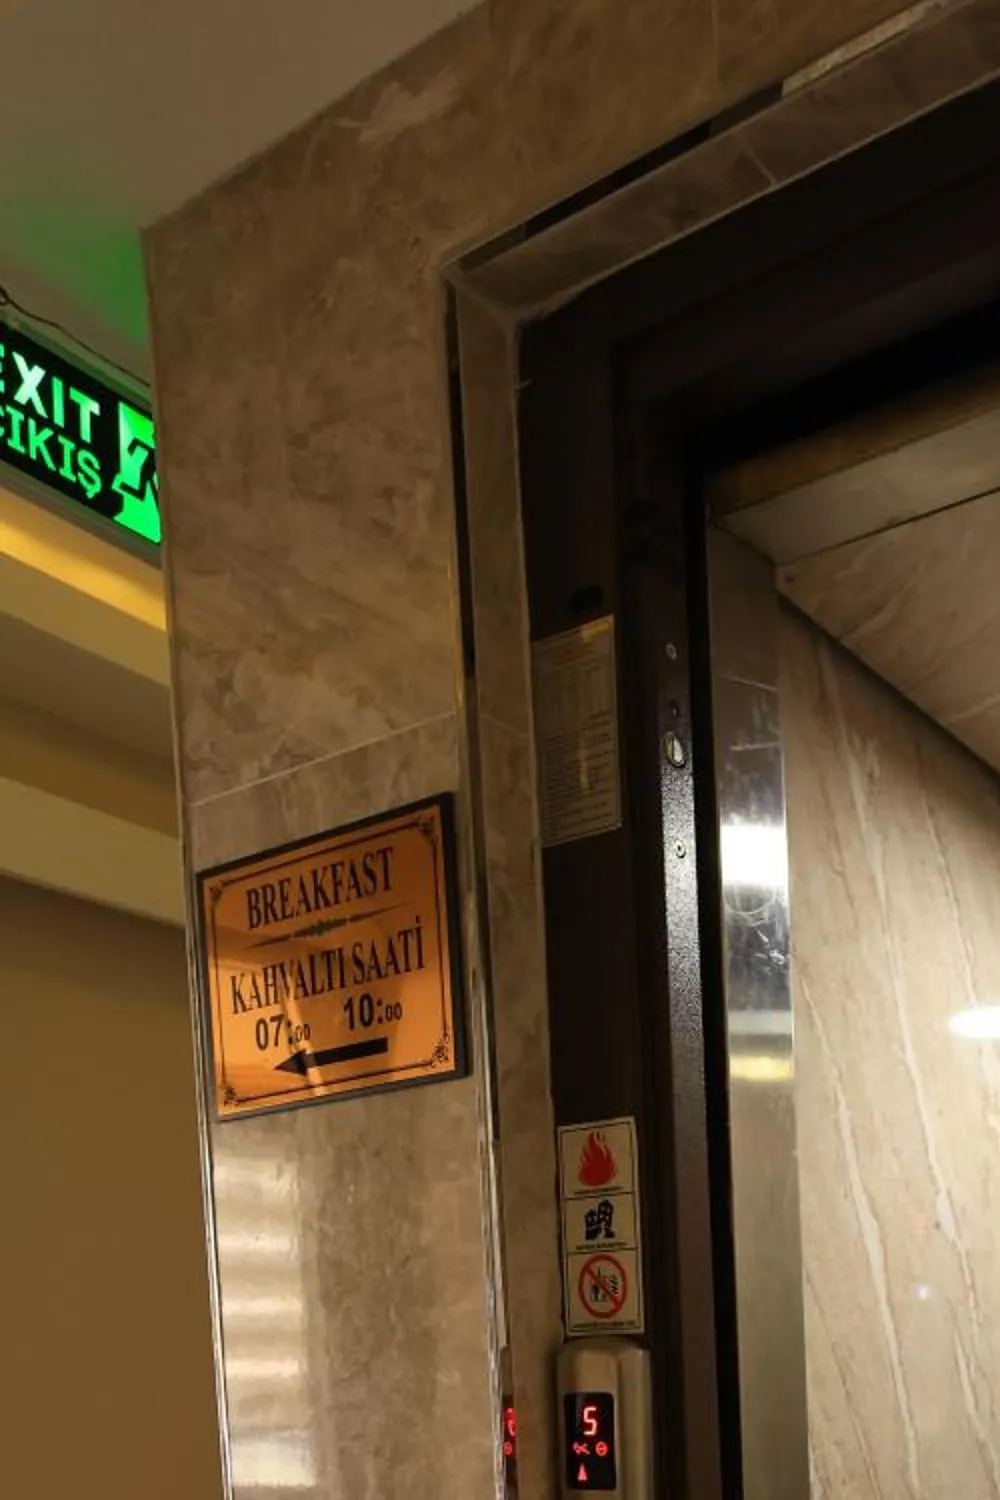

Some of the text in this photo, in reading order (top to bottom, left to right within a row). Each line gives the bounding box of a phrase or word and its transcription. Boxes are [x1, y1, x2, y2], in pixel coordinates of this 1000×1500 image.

[0, 343, 100, 443] XIT
[0, 404, 102, 499] IKIŞ
[246, 847, 394, 930] BREAKFAST
[230, 916, 424, 1015] KAHVALTI SAATİ
[583, 1406, 598, 1435] 5
